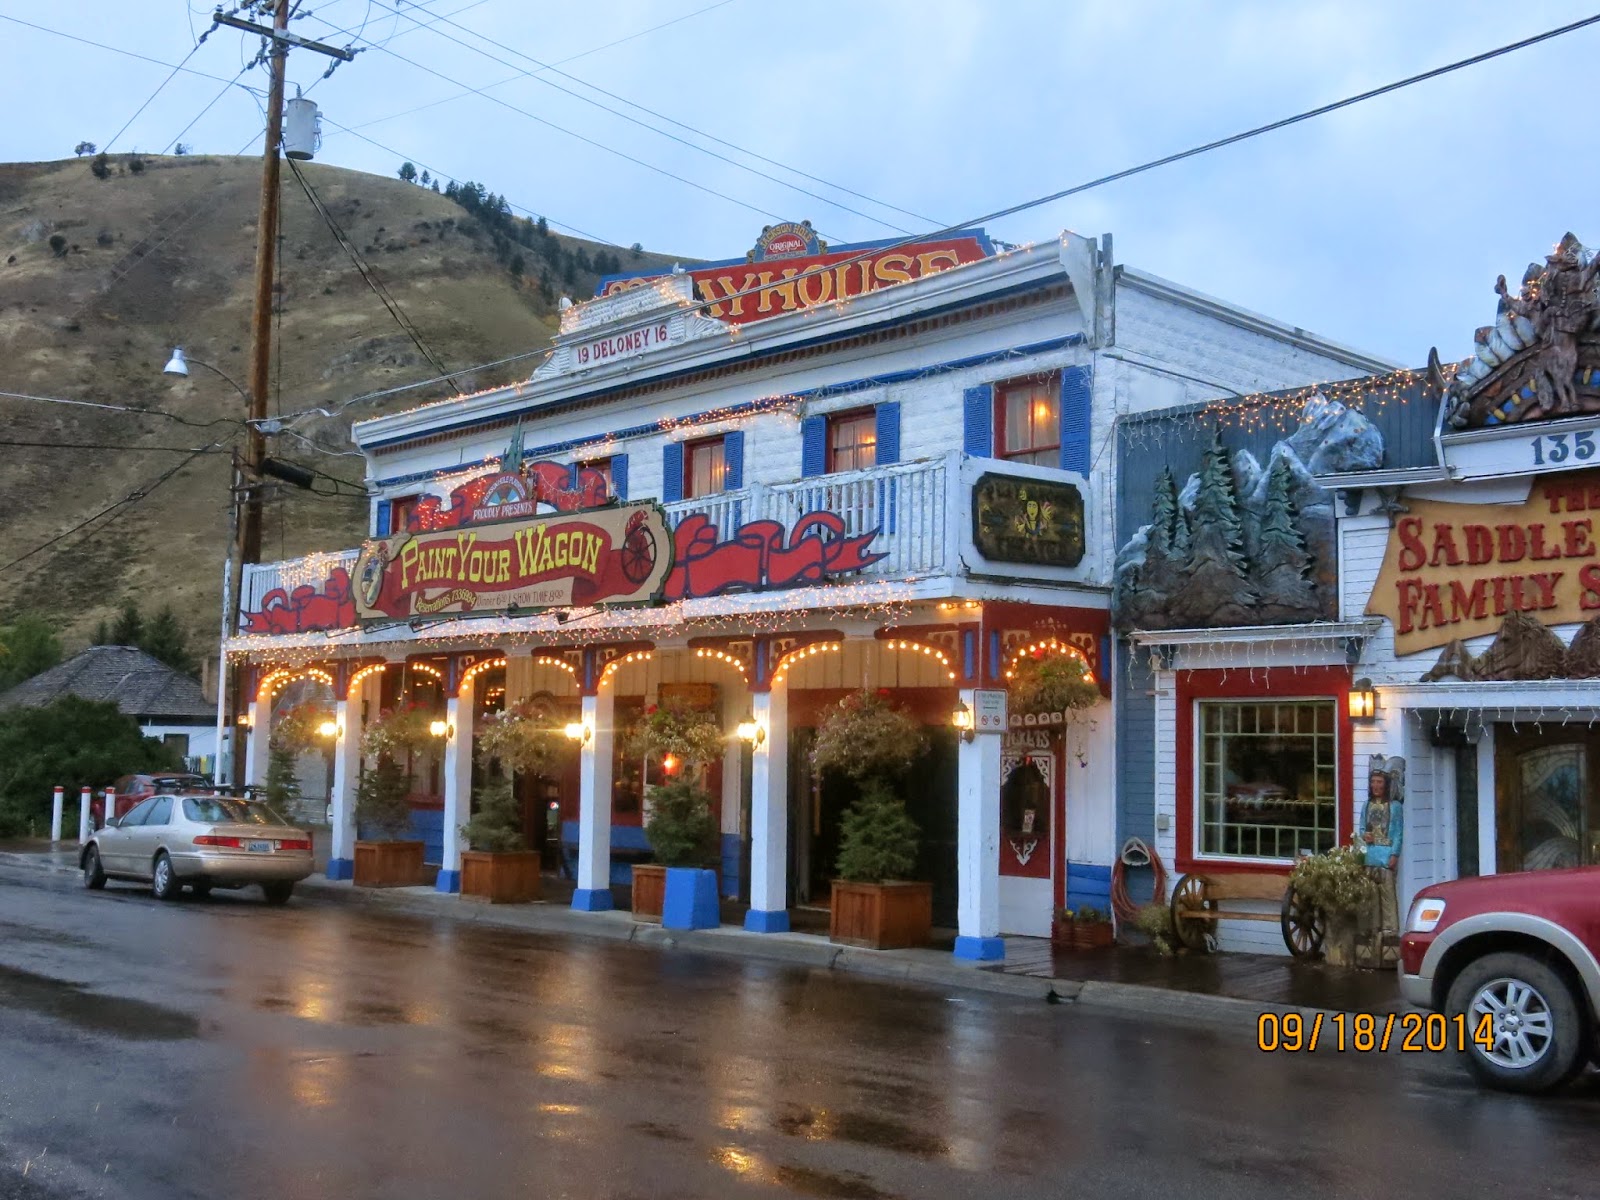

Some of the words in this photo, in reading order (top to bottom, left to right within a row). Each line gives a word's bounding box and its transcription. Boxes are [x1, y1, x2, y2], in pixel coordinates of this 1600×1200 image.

[761, 224, 791, 249] JACKSON
[793, 224, 812, 242] HOLE
[769, 240, 803, 253] ORIGINAL
[608, 249, 959, 319] AYHOUSE
[577, 346, 589, 364] 19
[593, 328, 650, 360] DELONEY
[655, 324, 667, 343] 16
[1530, 430, 1596, 465] 135
[473, 507, 500, 520] PROUDLY
[501, 501, 533, 517] PRESENTS
[1544, 486, 1600, 513] THE
[401, 538, 457, 590] PAINT
[457, 531, 511, 583] YOUR
[514, 523, 603, 578] WAGON
[1397, 517, 1596, 571] SADDLE
[1395, 572, 1565, 636] FAMILY
